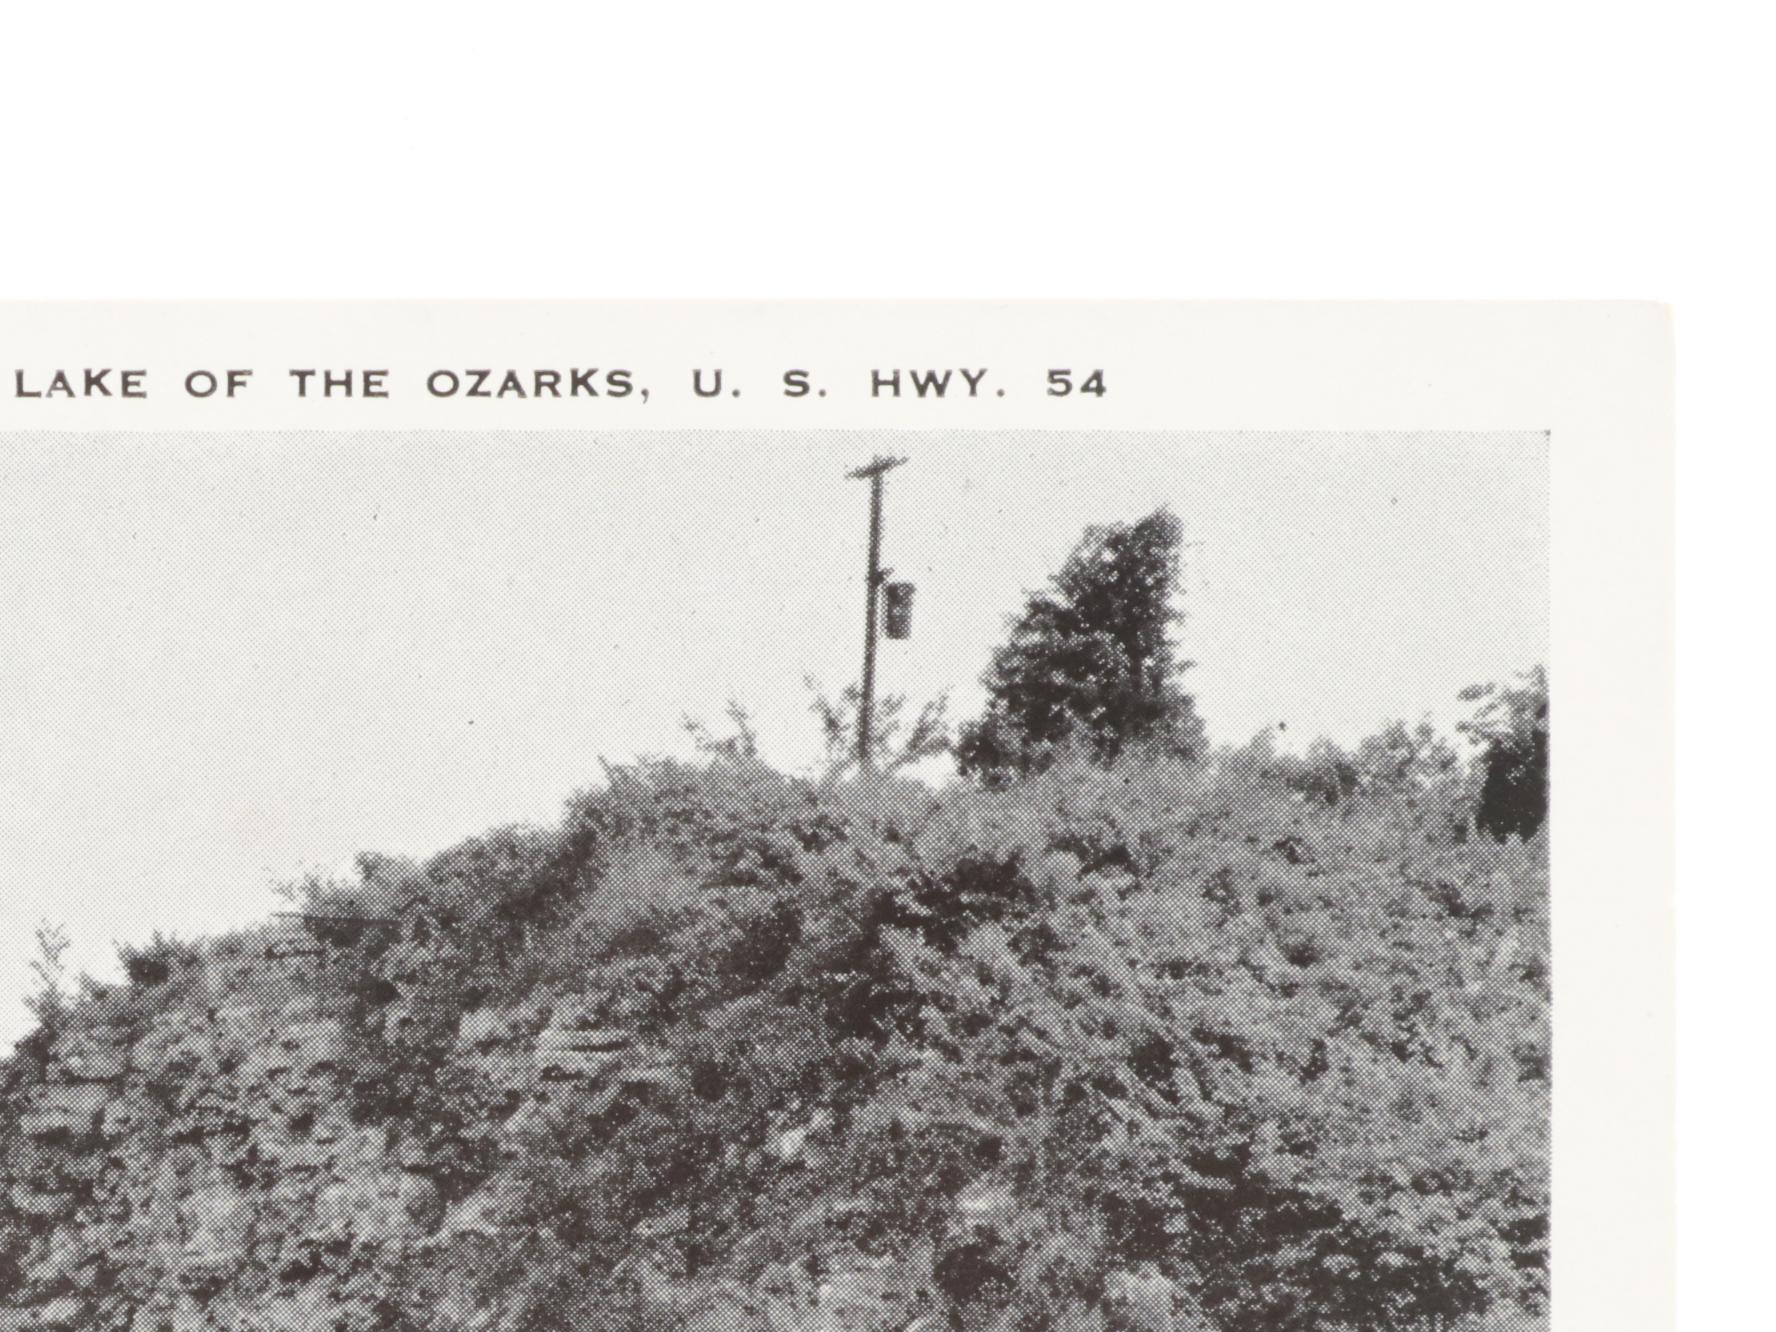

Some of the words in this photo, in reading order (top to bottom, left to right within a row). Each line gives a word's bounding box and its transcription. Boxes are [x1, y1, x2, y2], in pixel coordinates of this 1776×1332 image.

[17, 370, 145, 397] LAKE
[186, 371, 251, 397] OF
[290, 370, 388, 397] THE
[428, 370, 647, 401] OZARKS,
[695, 371, 738, 396] U.
[784, 371, 824, 396] S.
[873, 370, 1003, 397] HWY.
[1049, 371, 1105, 396] 54
